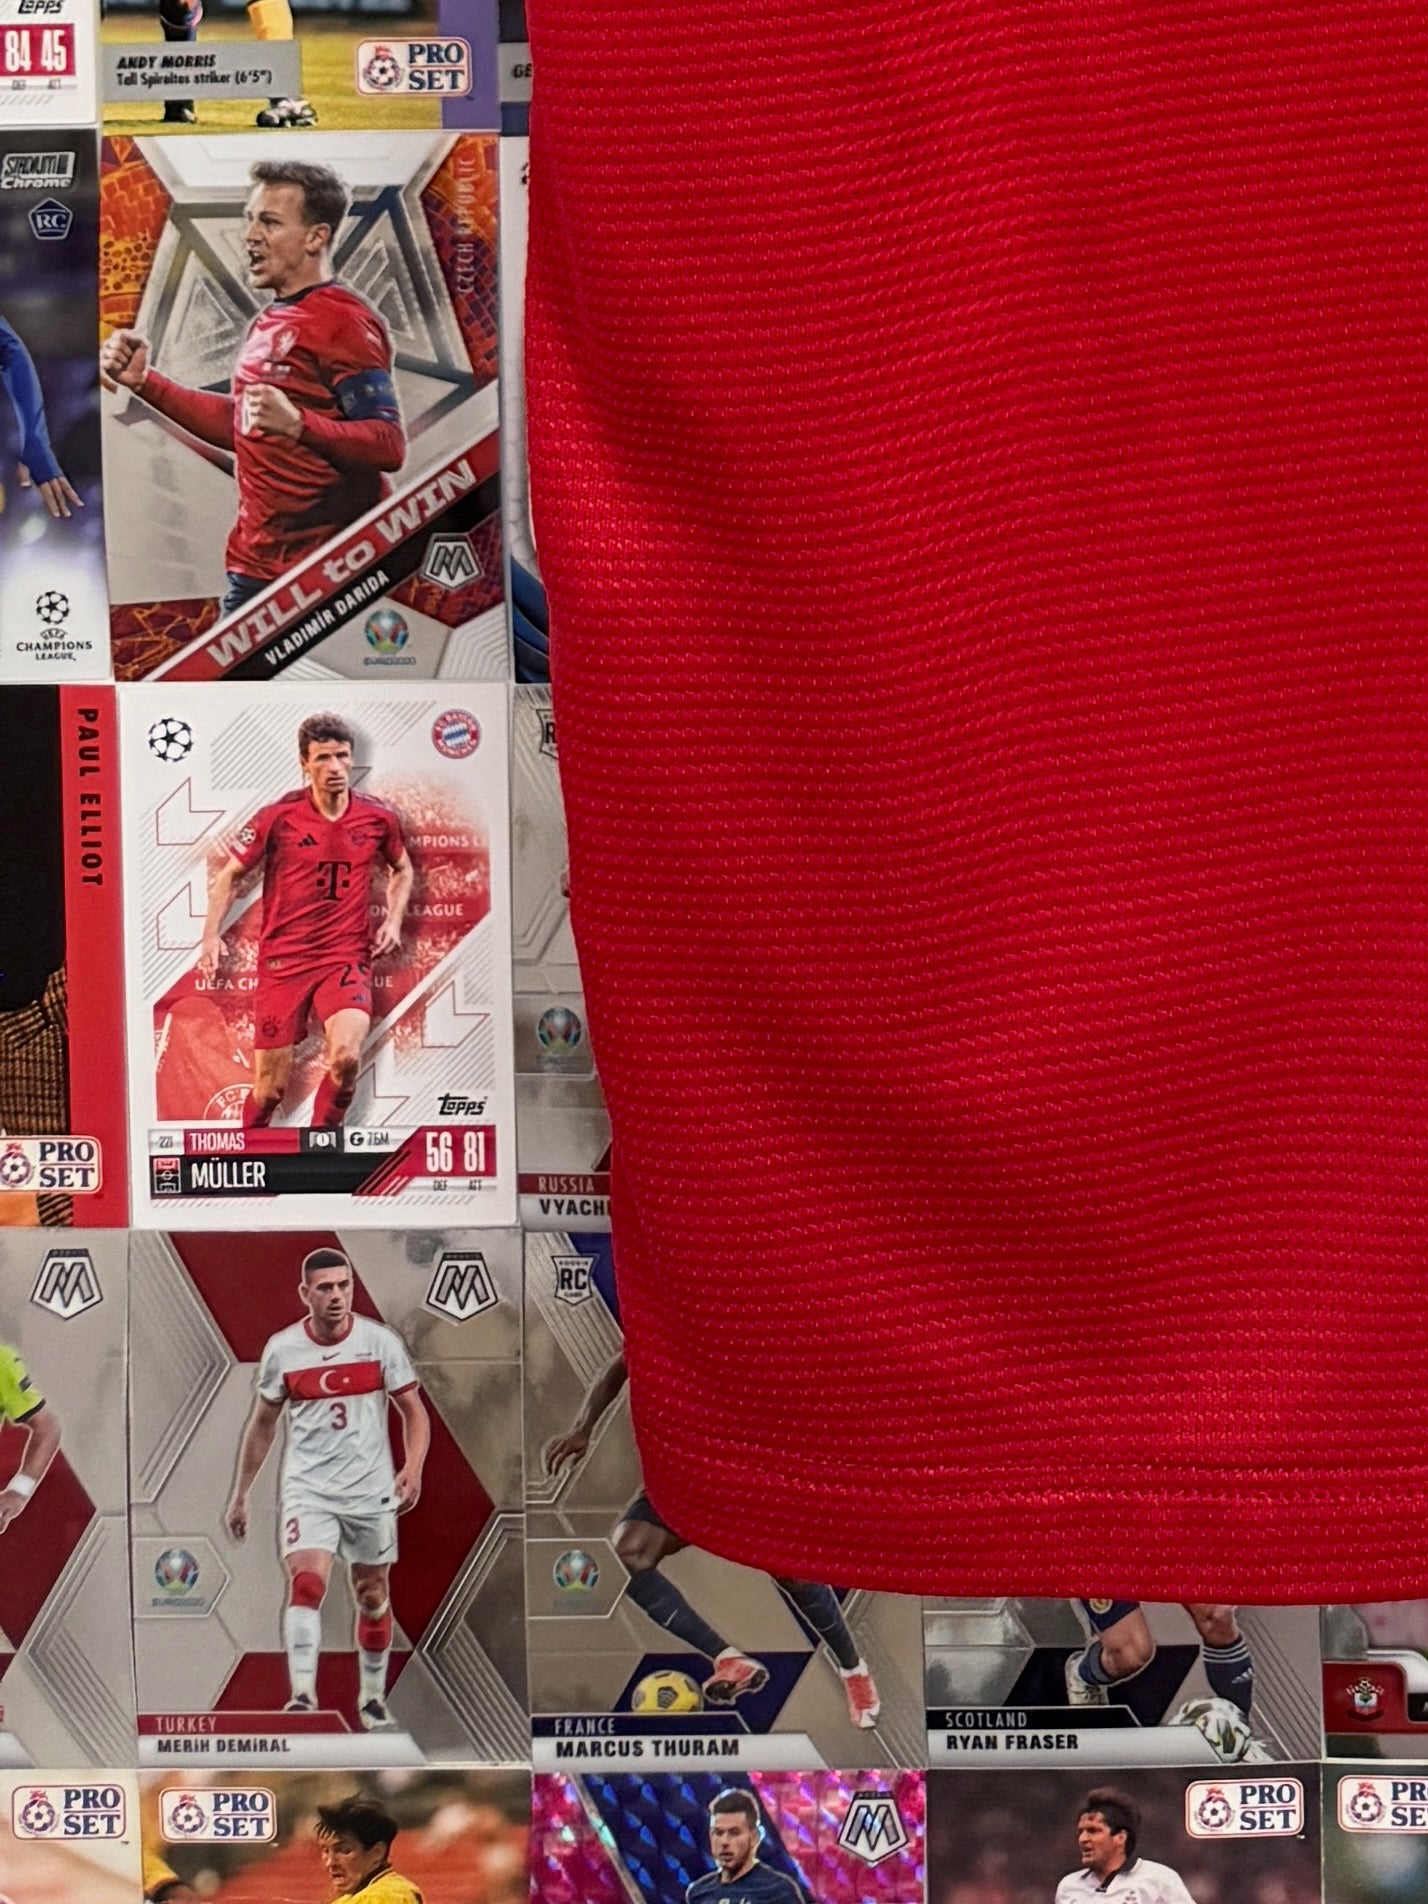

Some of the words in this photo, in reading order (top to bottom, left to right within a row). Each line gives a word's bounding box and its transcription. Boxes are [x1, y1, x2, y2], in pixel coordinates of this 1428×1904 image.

[117, 55, 157, 69] ANDY
[161, 55, 216, 68] MORRIS
[408, 43, 464, 64] PRO
[408, 69, 464, 90] SET
[206, 584, 324, 670] WILL
[322, 541, 377, 581] to
[377, 459, 477, 543] WIN
[264, 605, 334, 666] VLADIMÍR
[335, 569, 391, 617] DARIDA
[16, 640, 92, 652] CHAMPIONS
[77, 707, 100, 778] PAUL
[80, 794, 105, 887] ELLIOT
[189, 1132, 245, 1152] THOMAS
[425, 1135, 453, 1173] 56
[464, 1134, 487, 1172] 81
[191, 1160, 266, 1189] MÜLLER
[538, 1177, 594, 1193] RUSSIA
[156, 1716, 217, 1733] TURKEY
[555, 1718, 615, 1735] FRANCE
[946, 1712, 1027, 1728] SCOTLAND
[556, 1740, 644, 1758] MARCUS
[652, 1739, 739, 1756] THURAM
[947, 1734, 998, 1750] RYAN
[1005, 1733, 1079, 1749] FRASER
[63, 1788, 120, 1809] PRO
[1239, 1785, 1297, 1805] PRO
[63, 1814, 121, 1835] SET
[1239, 1809, 1297, 1831] SET
